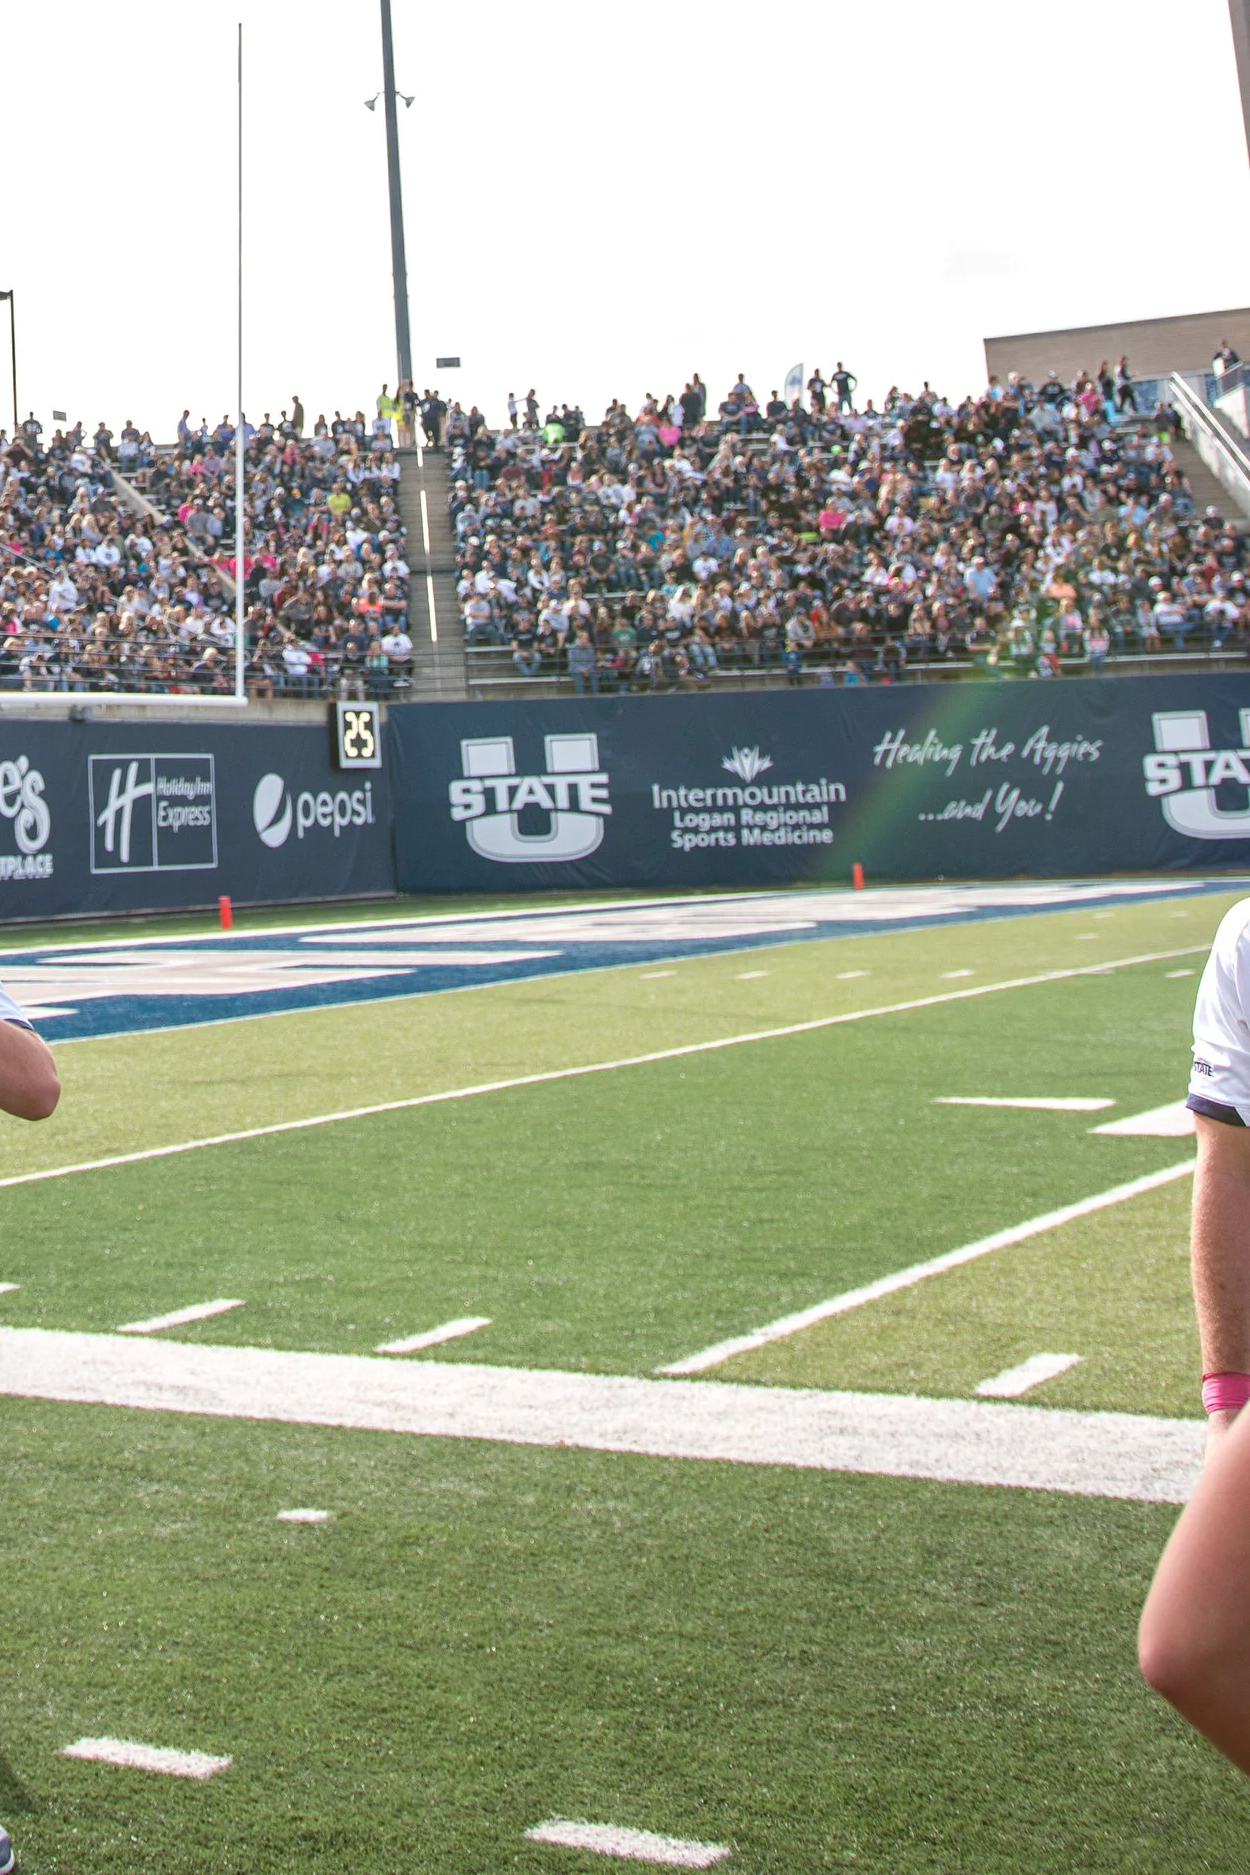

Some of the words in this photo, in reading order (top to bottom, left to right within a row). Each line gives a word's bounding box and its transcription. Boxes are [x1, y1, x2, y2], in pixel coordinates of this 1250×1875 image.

[873, 728, 963, 777] Healing
[969, 727, 1015, 767] the
[1021, 725, 1104, 775] Aggies
[157, 776, 195, 800] Holiday
[196, 776, 213, 795] Inn
[652, 777, 847, 809] Intermountain
[1142, 749, 1250, 797] STA
[157, 800, 211, 833] Express
[297, 781, 373, 839] pepsi
[448, 772, 613, 821] STATE
[995, 780, 1065, 833] You!
[673, 809, 736, 831] Logan
[740, 804, 829, 830] Regional
[671, 829, 736, 852] Sports
[741, 825, 833, 846] Medicine
